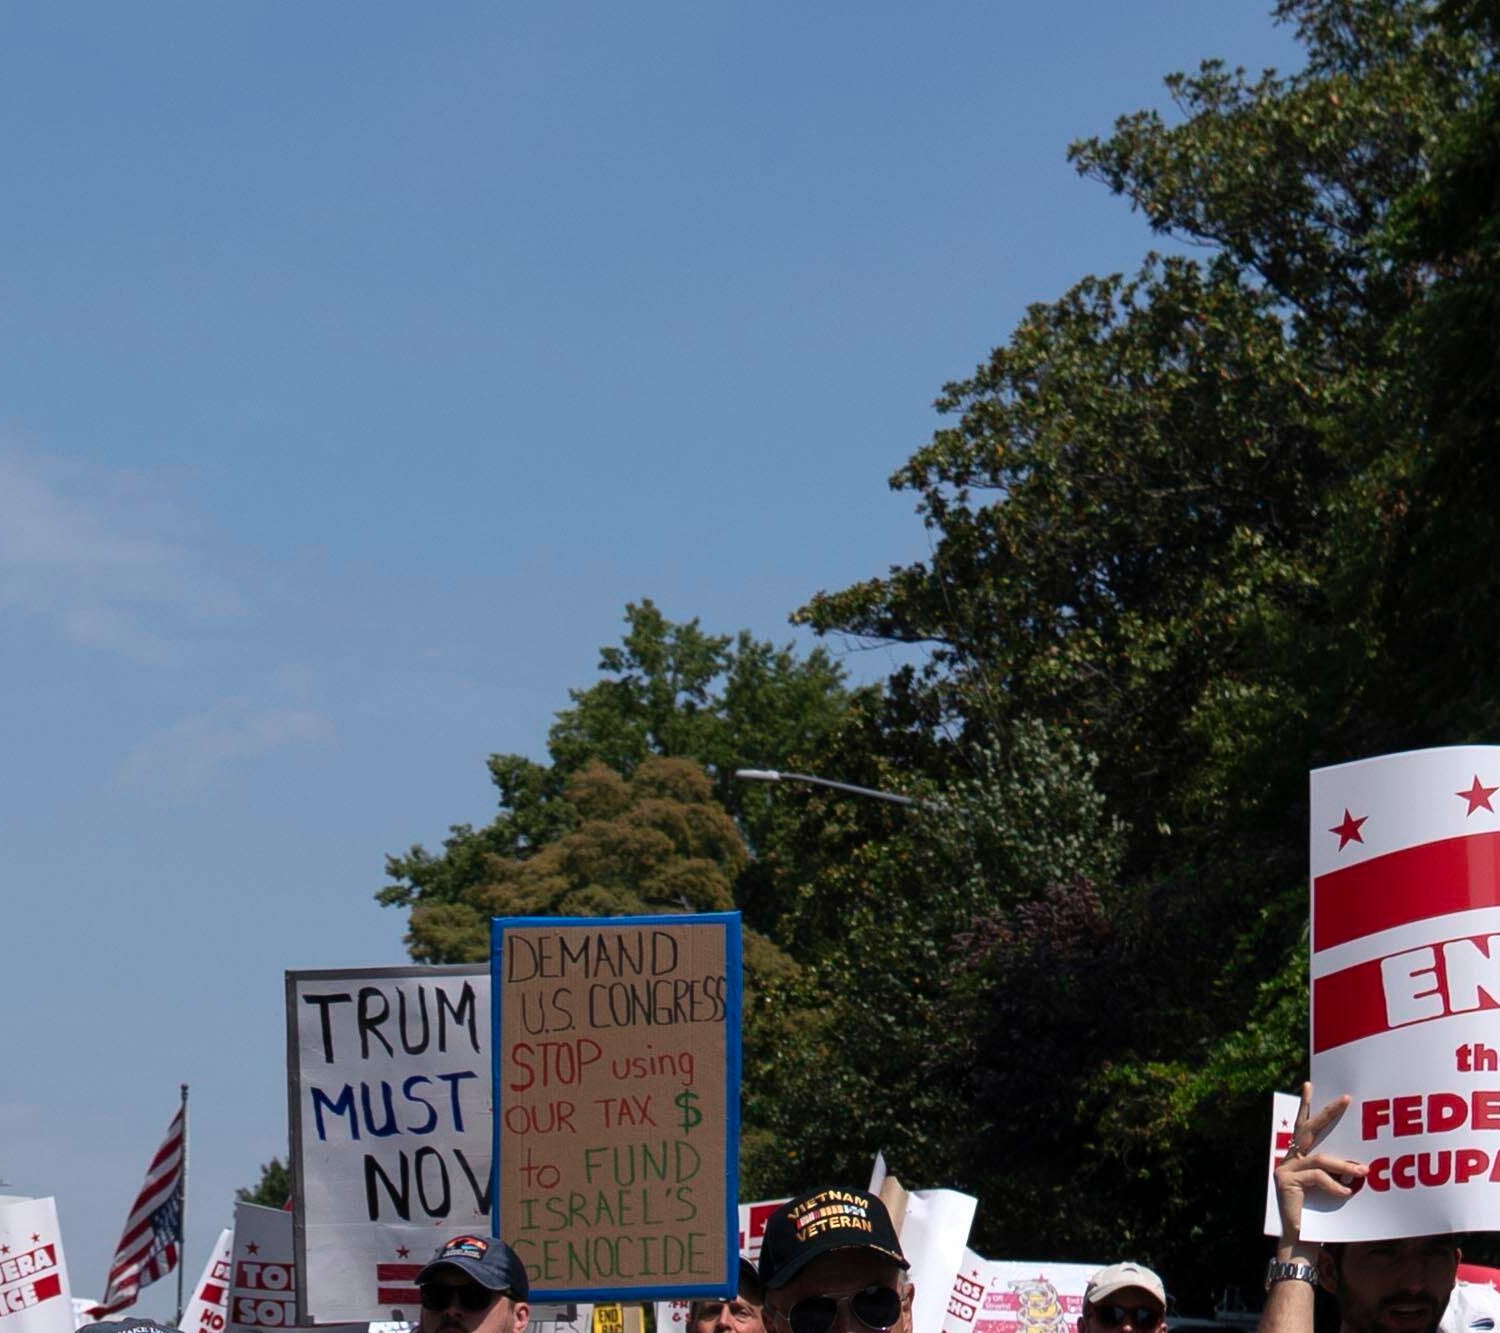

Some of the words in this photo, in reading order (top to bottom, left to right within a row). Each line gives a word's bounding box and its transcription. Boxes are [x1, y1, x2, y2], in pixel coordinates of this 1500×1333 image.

[507, 931, 678, 983] DEMAND
[302, 980, 480, 1064] TRUM
[522, 988, 575, 1035] U.S.
[589, 975, 727, 1028] CONGRESS
[510, 1038, 602, 1092] STOP
[611, 1045, 694, 1086] using
[310, 1071, 478, 1141] MUST
[505, 1100, 576, 1134] OUR
[593, 1096, 657, 1128] TAX
[520, 1148, 560, 1189] to
[585, 1140, 701, 1186] FUND
[520, 1186, 698, 1231] ISRAEL'S
[787, 1190, 869, 1219] VIETNAM
[795, 1216, 873, 1243] VETERAN
[511, 1233, 711, 1282] GENOCIDE
[599, 1308, 618, 1323] END
